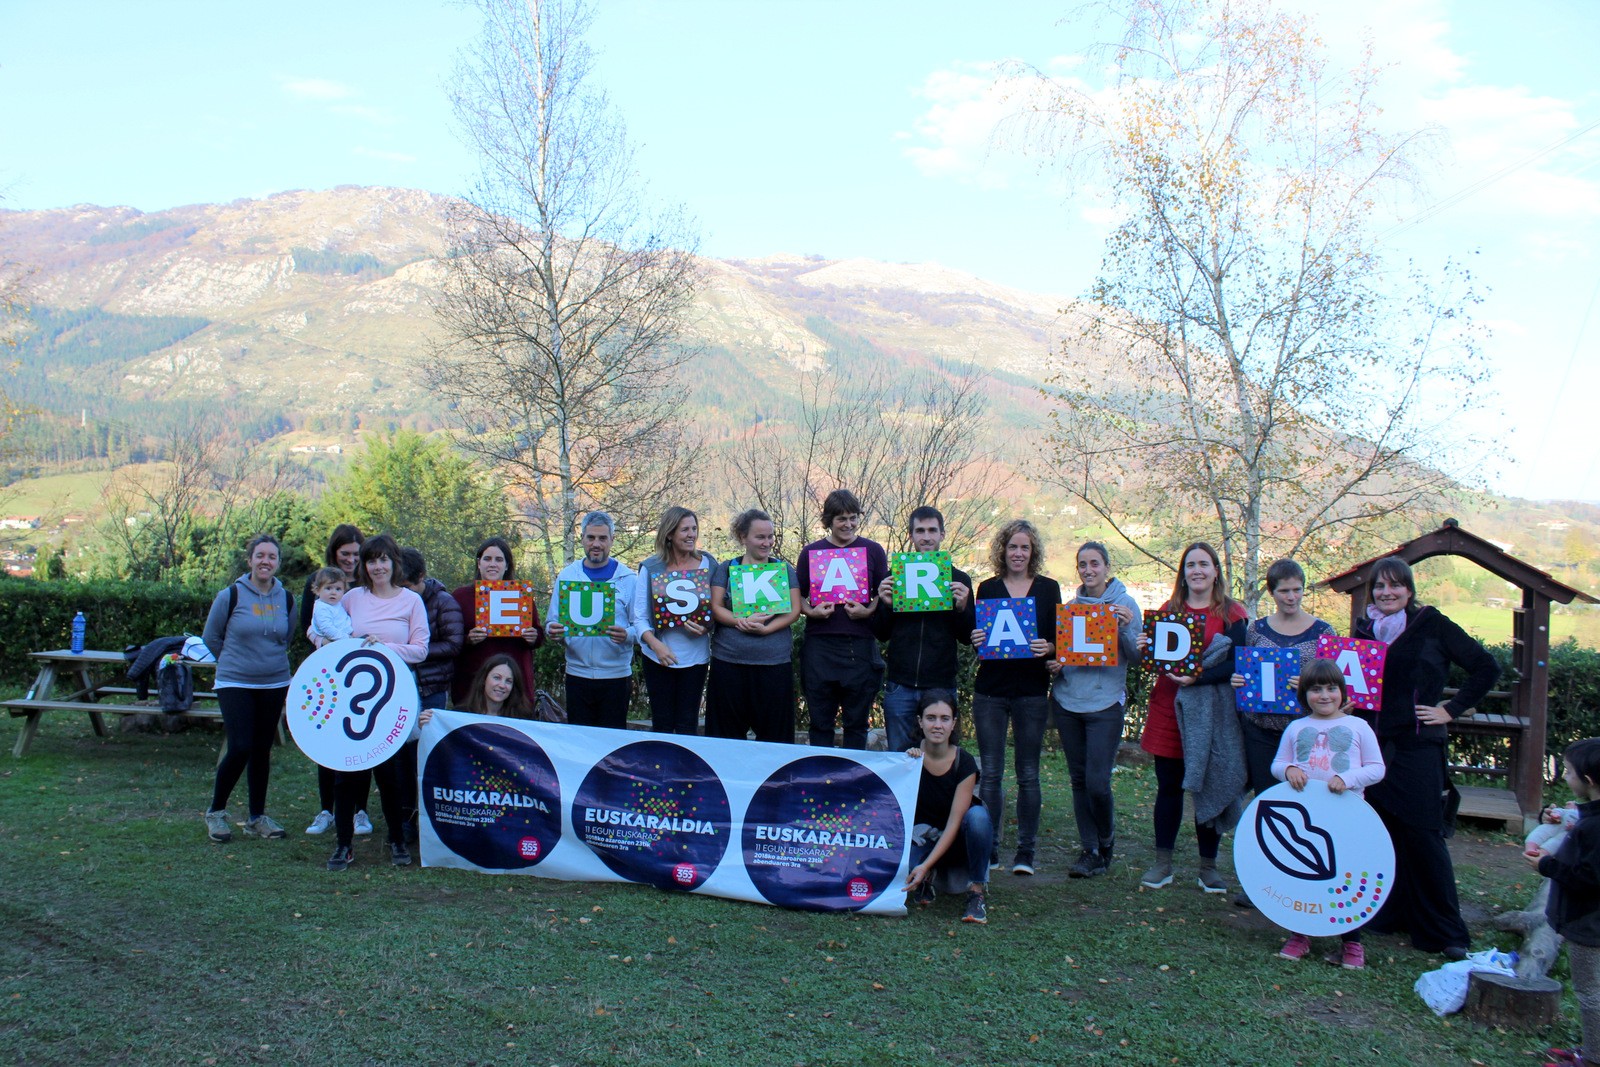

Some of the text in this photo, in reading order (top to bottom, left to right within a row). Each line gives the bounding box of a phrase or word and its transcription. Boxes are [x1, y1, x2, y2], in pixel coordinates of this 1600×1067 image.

[742, 570, 784, 604] K
[820, 557, 859, 593] A
[903, 563, 943, 599] R
[489, 591, 522, 625] E
[568, 591, 604, 626] U
[665, 579, 699, 615] S
[988, 610, 1028, 647] A
[1069, 616, 1104, 654] L
[1154, 622, 1191, 662] D
[1261, 663, 1276, 702] I
[1335, 650, 1369, 695] A
[345, 706, 409, 767] BELARRIPREST
[433, 786, 549, 814] EUSKARALDIA
[440, 804, 461, 814] EGUN
[462, 807, 502, 817] EUSKARAZ
[453, 814, 480, 823] azaroaren
[585, 807, 715, 836] EUSKARALDIA
[592, 826, 615, 836] EGUN
[616, 829, 659, 841] EUSKARAZ
[605, 837, 635, 846] azaroaren
[635, 840, 651, 848] 23tik
[755, 825, 889, 849] EUSKARALDIA
[763, 845, 786, 854] EGUN
[788, 847, 831, 857] EUSKARAZ
[753, 859, 790, 867] abenduaren
[776, 855, 807, 863] azaroaren
[1262, 886, 1323, 914] AHOBIZI
